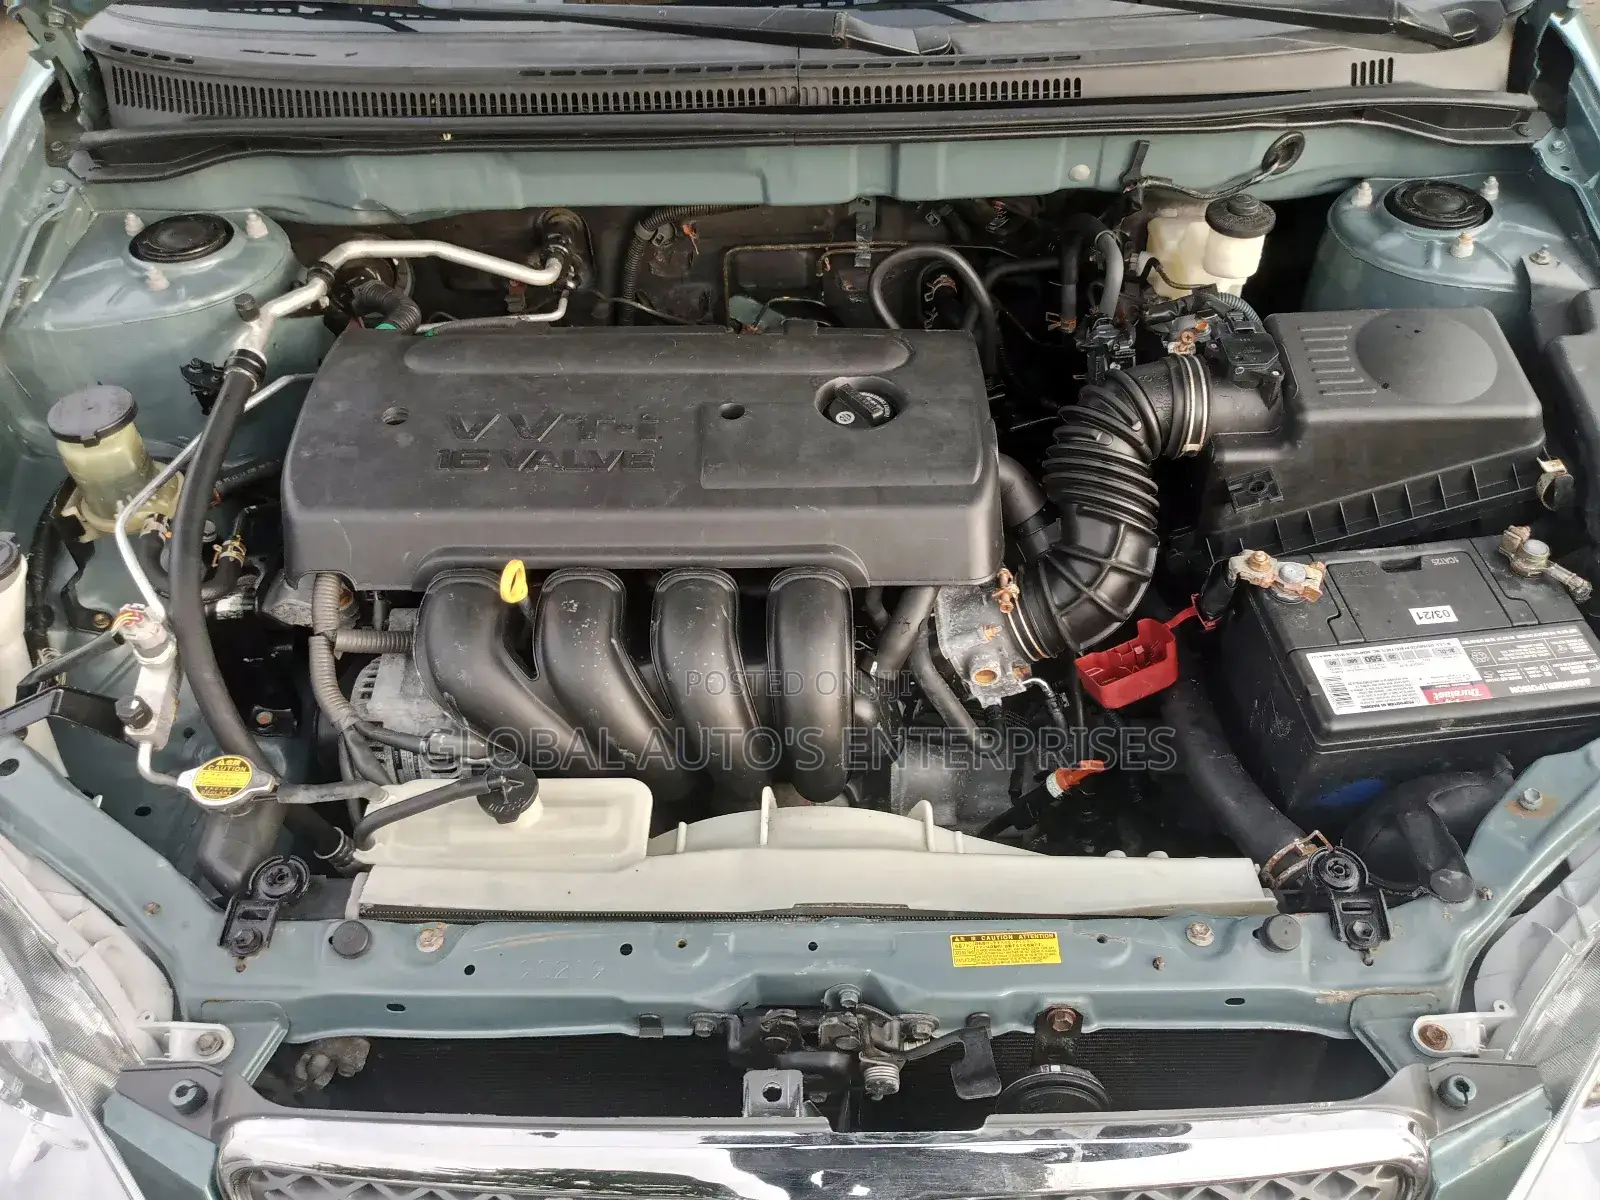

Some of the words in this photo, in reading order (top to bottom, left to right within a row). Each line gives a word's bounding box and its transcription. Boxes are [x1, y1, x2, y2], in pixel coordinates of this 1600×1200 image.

[437, 449, 491, 471] 16
[501, 449, 656, 471] VALVE
[1416, 609, 1450, 620] 03/21
[1364, 654, 1382, 663] 550
[1433, 687, 1482, 700] Duralast
